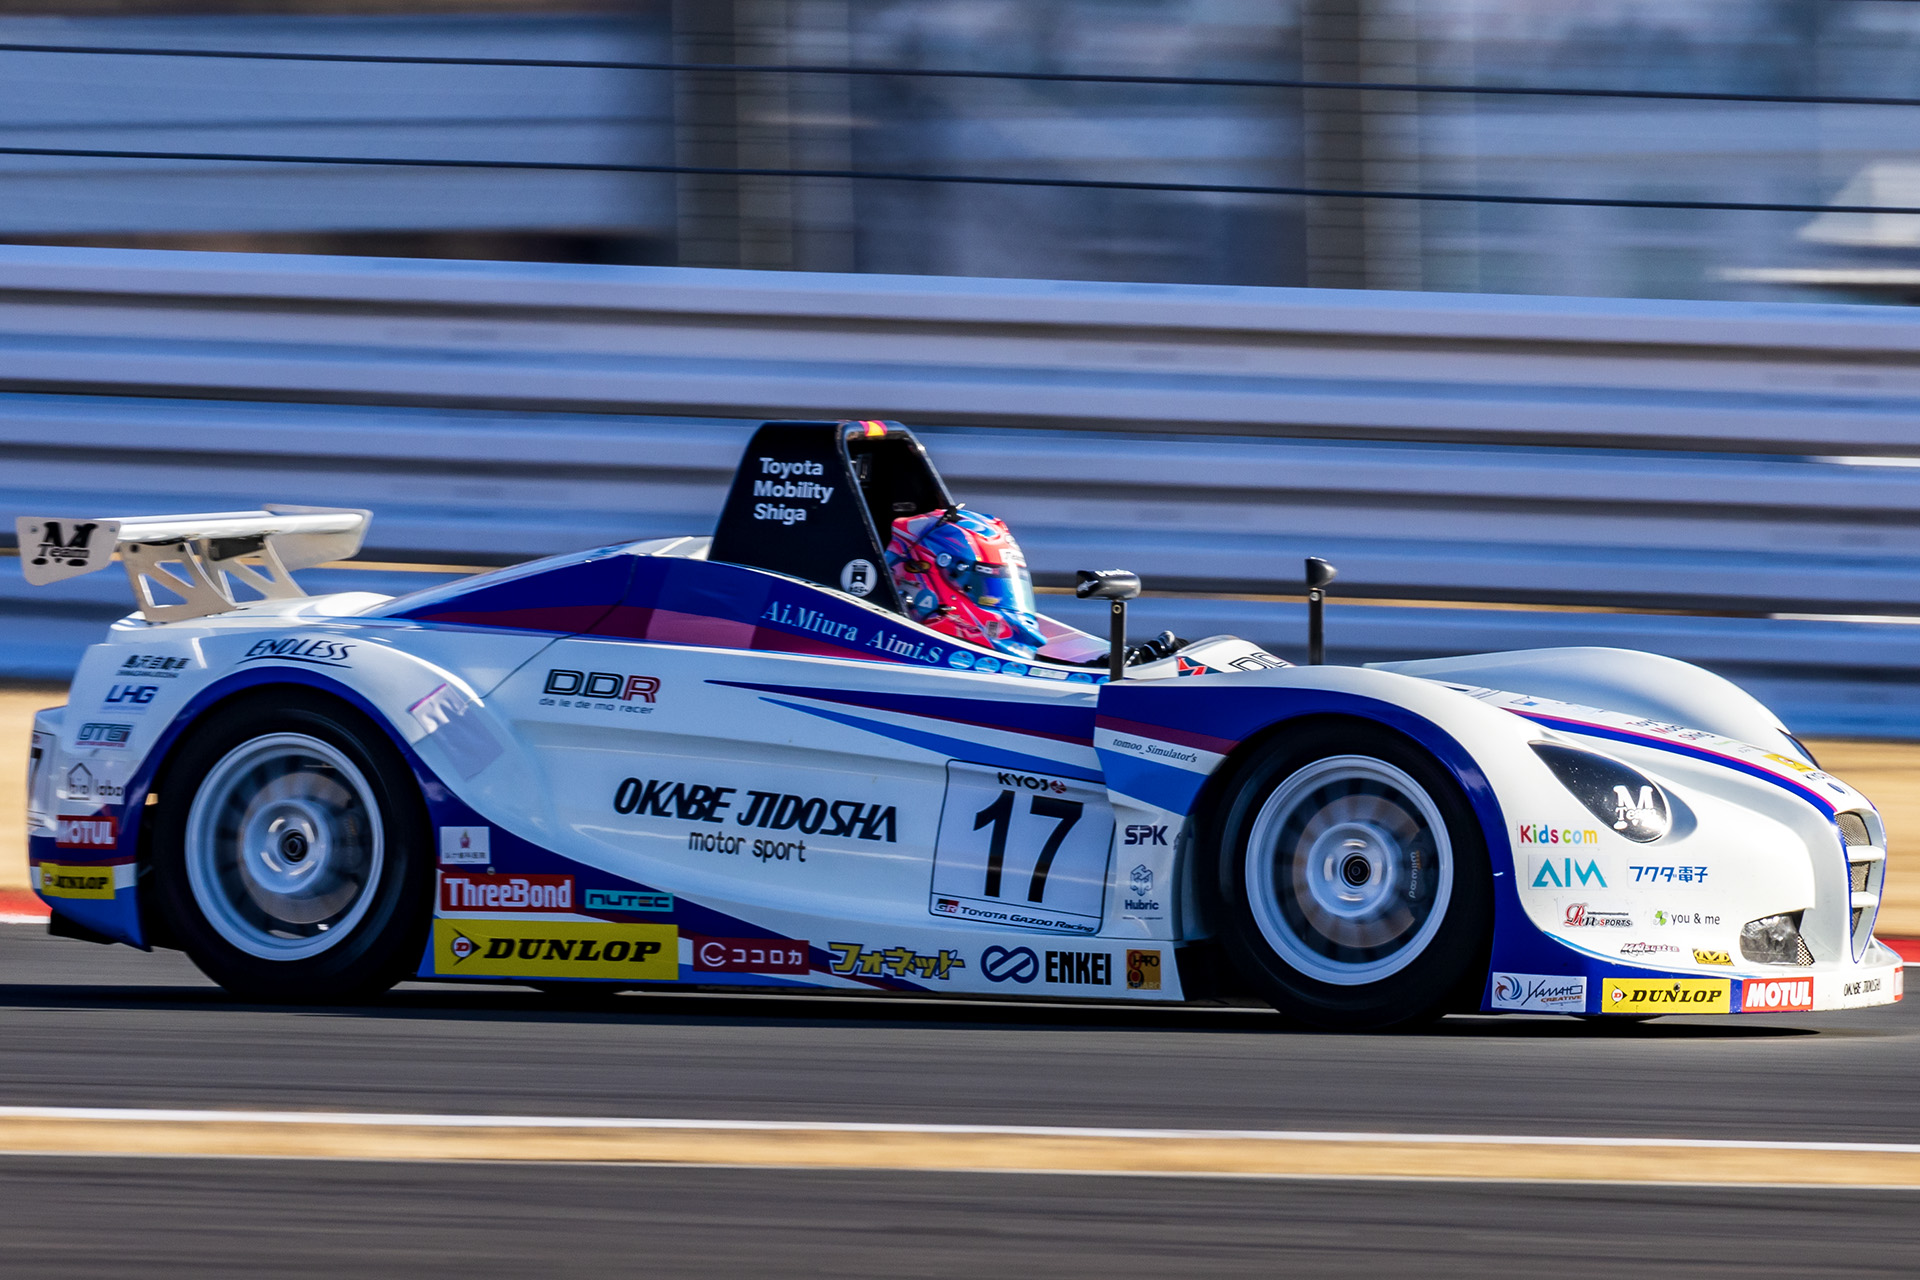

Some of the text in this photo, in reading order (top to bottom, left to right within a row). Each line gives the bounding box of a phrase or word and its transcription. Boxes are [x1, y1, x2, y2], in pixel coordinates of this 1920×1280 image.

[759, 457, 824, 479] Toyota
[753, 480, 834, 504] Mobility
[753, 503, 807, 525] Shiga
[38, 543, 90, 559] Team
[760, 601, 859, 642] Ai.Miura
[865, 630, 943, 664] Aimi.S
[244, 637, 357, 661] ENDLESS
[104, 684, 159, 704] LHG
[575, 700, 591, 711] de
[595, 702, 615, 713] mo
[619, 704, 654, 715] racer
[1112, 738, 1198, 763] tomoo_Simulator's
[614, 777, 897, 842] OKABE JIDOSHA
[57, 821, 116, 845] MOTUL
[1124, 825, 1169, 845] SPK
[1520, 824, 1598, 845] Kids com
[688, 831, 807, 862] motor sport
[973, 789, 1084, 904] 17
[1629, 865, 1709, 884] フクダ電子
[444, 878, 572, 908] ThreeBond
[1124, 899, 1160, 911] Hubric
[962, 906, 1008, 921] TOYOTA
[1010, 913, 1054, 927] GAZOO
[1055, 920, 1095, 933] Racing
[1671, 912, 1721, 925] you & me
[484, 938, 662, 962] DUNLOP
[732, 948, 803, 966] ココロカ
[827, 941, 967, 981] フォネット
[1045, 950, 1112, 986] ENKEI
[1541, 995, 1582, 1003] CREATIVE
[1630, 989, 1723, 1003] DUNLOP
[1745, 981, 1812, 1008] MOTUL
